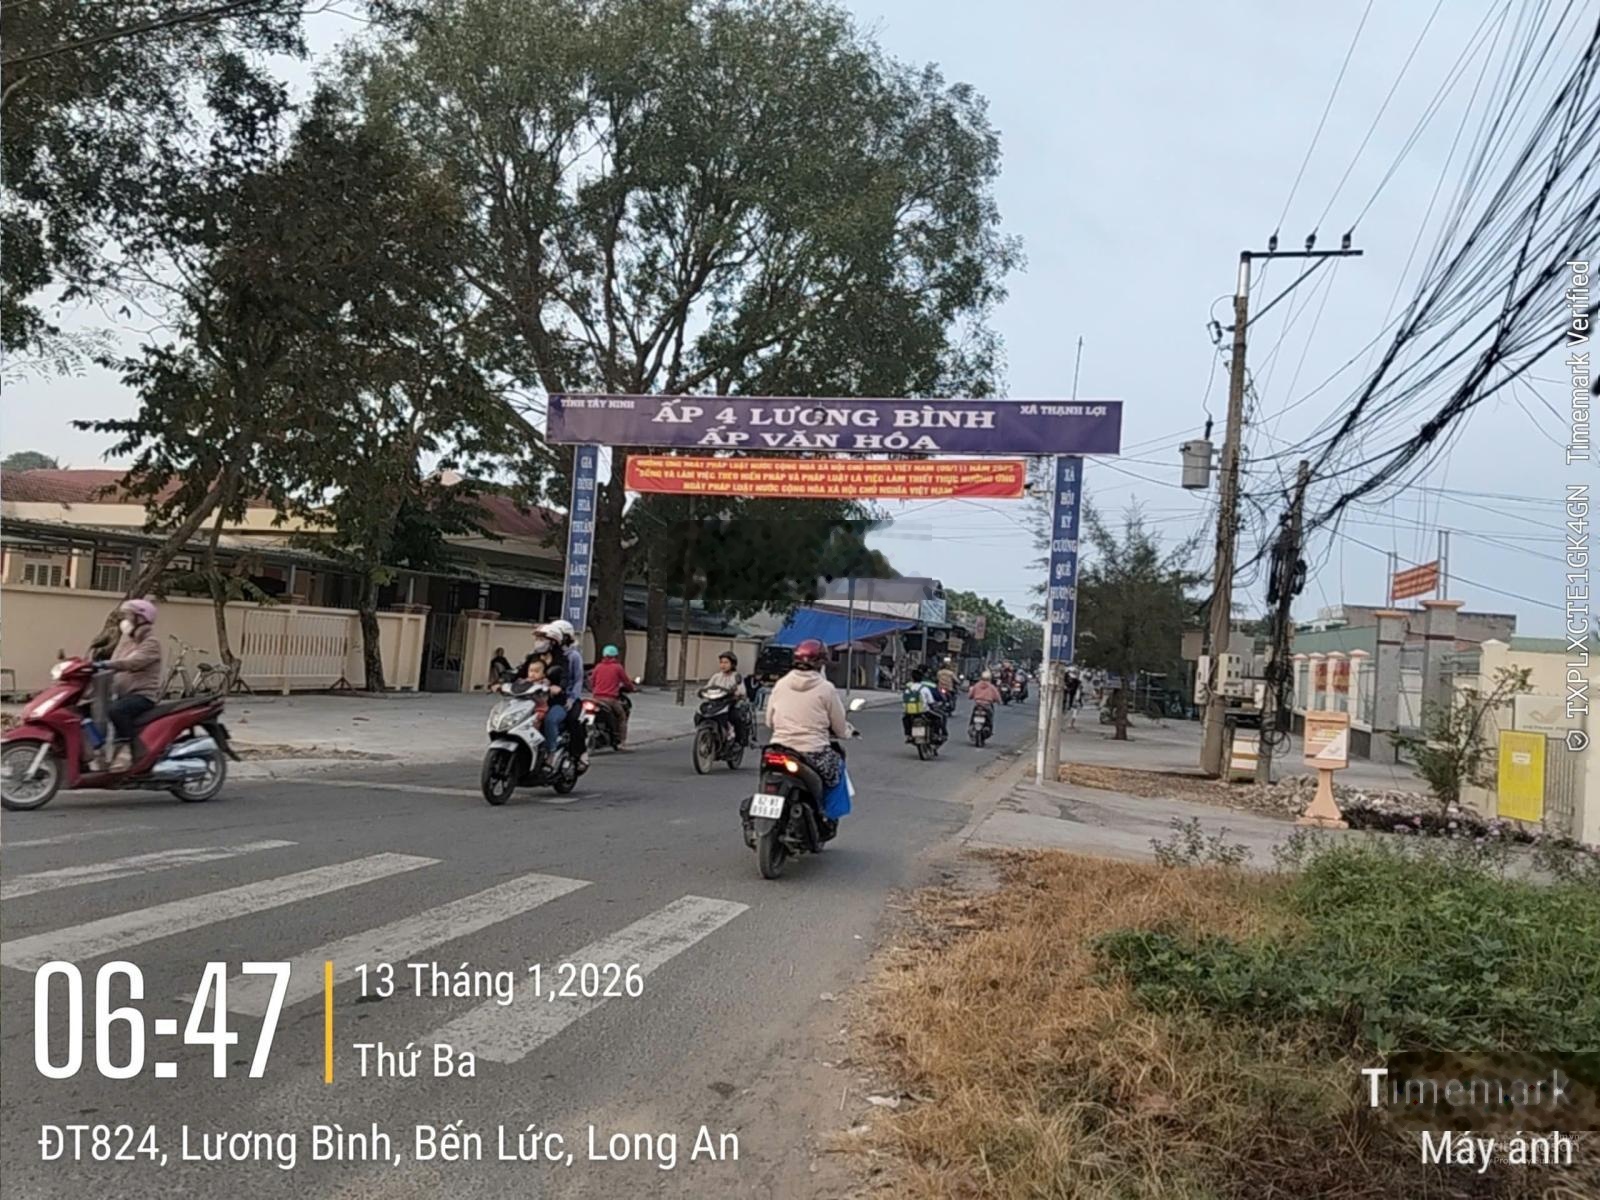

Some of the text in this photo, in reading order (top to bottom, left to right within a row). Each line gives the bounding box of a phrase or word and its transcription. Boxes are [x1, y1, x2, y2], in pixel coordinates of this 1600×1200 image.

[588, 398, 607, 408] TÂY
[609, 400, 635, 409] NINH
[1020, 404, 1107, 417] XÃ THẠNH LỢI
[652, 399, 996, 429] ẤP 4 LƯƠNG BÌNH
[698, 426, 941, 450] ẤP VĂN HÓA
